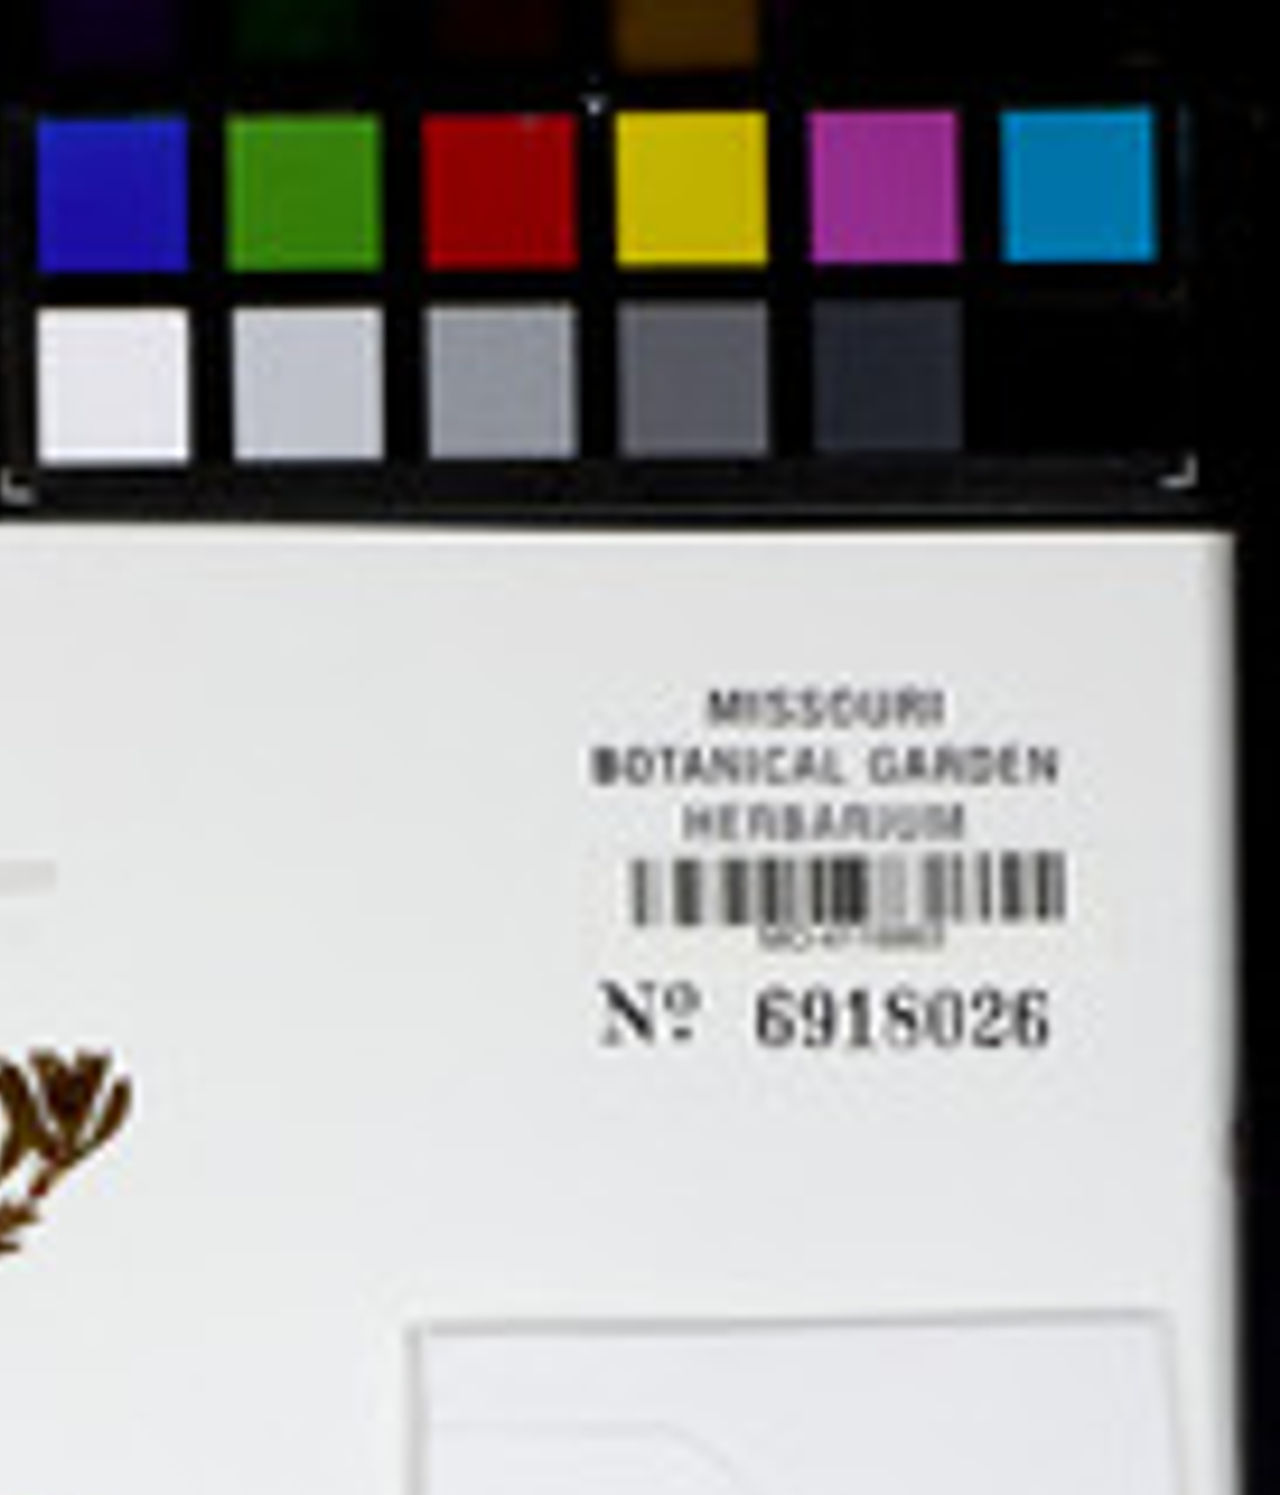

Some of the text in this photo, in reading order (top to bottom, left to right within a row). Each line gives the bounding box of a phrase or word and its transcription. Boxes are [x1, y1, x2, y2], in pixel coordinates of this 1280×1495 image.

[708, 689, 945, 727] MISSOURI
[592, 747, 1060, 785] BOTANICAL GARDEN
[681, 803, 965, 840] HERBARIUM
[755, 984, 1048, 1048] 6918026
